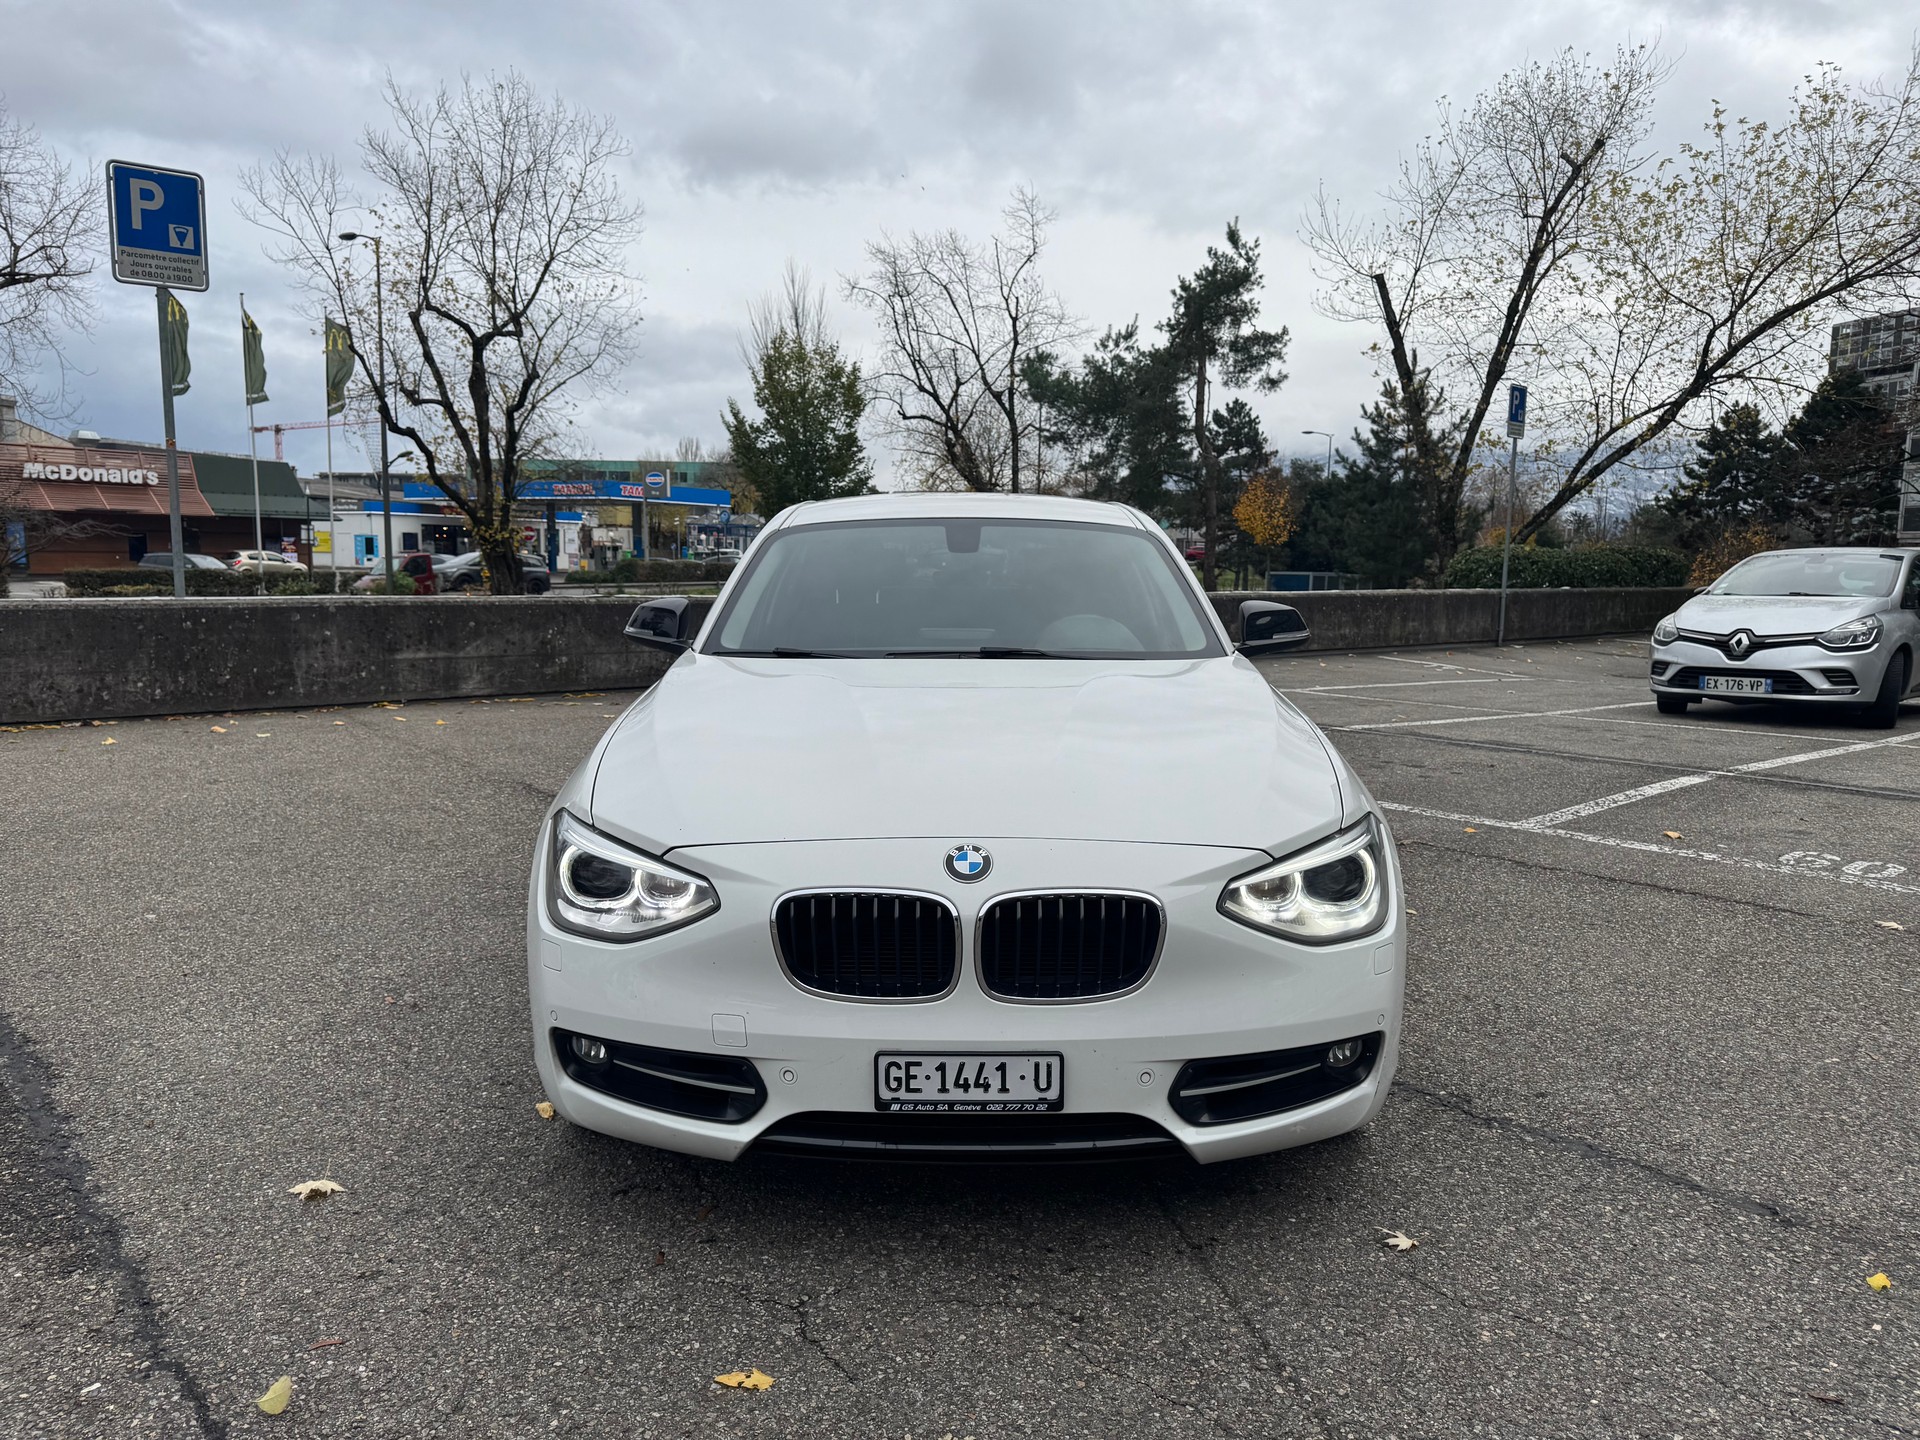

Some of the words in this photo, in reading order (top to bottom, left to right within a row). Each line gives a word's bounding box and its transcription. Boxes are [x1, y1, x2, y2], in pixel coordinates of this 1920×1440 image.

[130, 178, 165, 230] P
[121, 250, 167, 261] Parcomètre
[169, 257, 199, 266] collectif
[130, 260, 152, 268] Jours
[154, 265, 192, 274] ouvrables
[1512, 391, 1520, 414] P
[22, 462, 159, 486] McDonald's
[621, 485, 644, 496] TAM
[950, 845, 988, 857] BMW
[902, 1103, 914, 1111] GS
[915, 1103, 935, 1111] Auto
[936, 1103, 949, 1111] SA
[986, 1103, 1003, 1111] 022
[1004, 1103, 1021, 1111] 777
[1022, 1103, 1035, 1111] 70
[1036, 1103, 1048, 1111] 22
